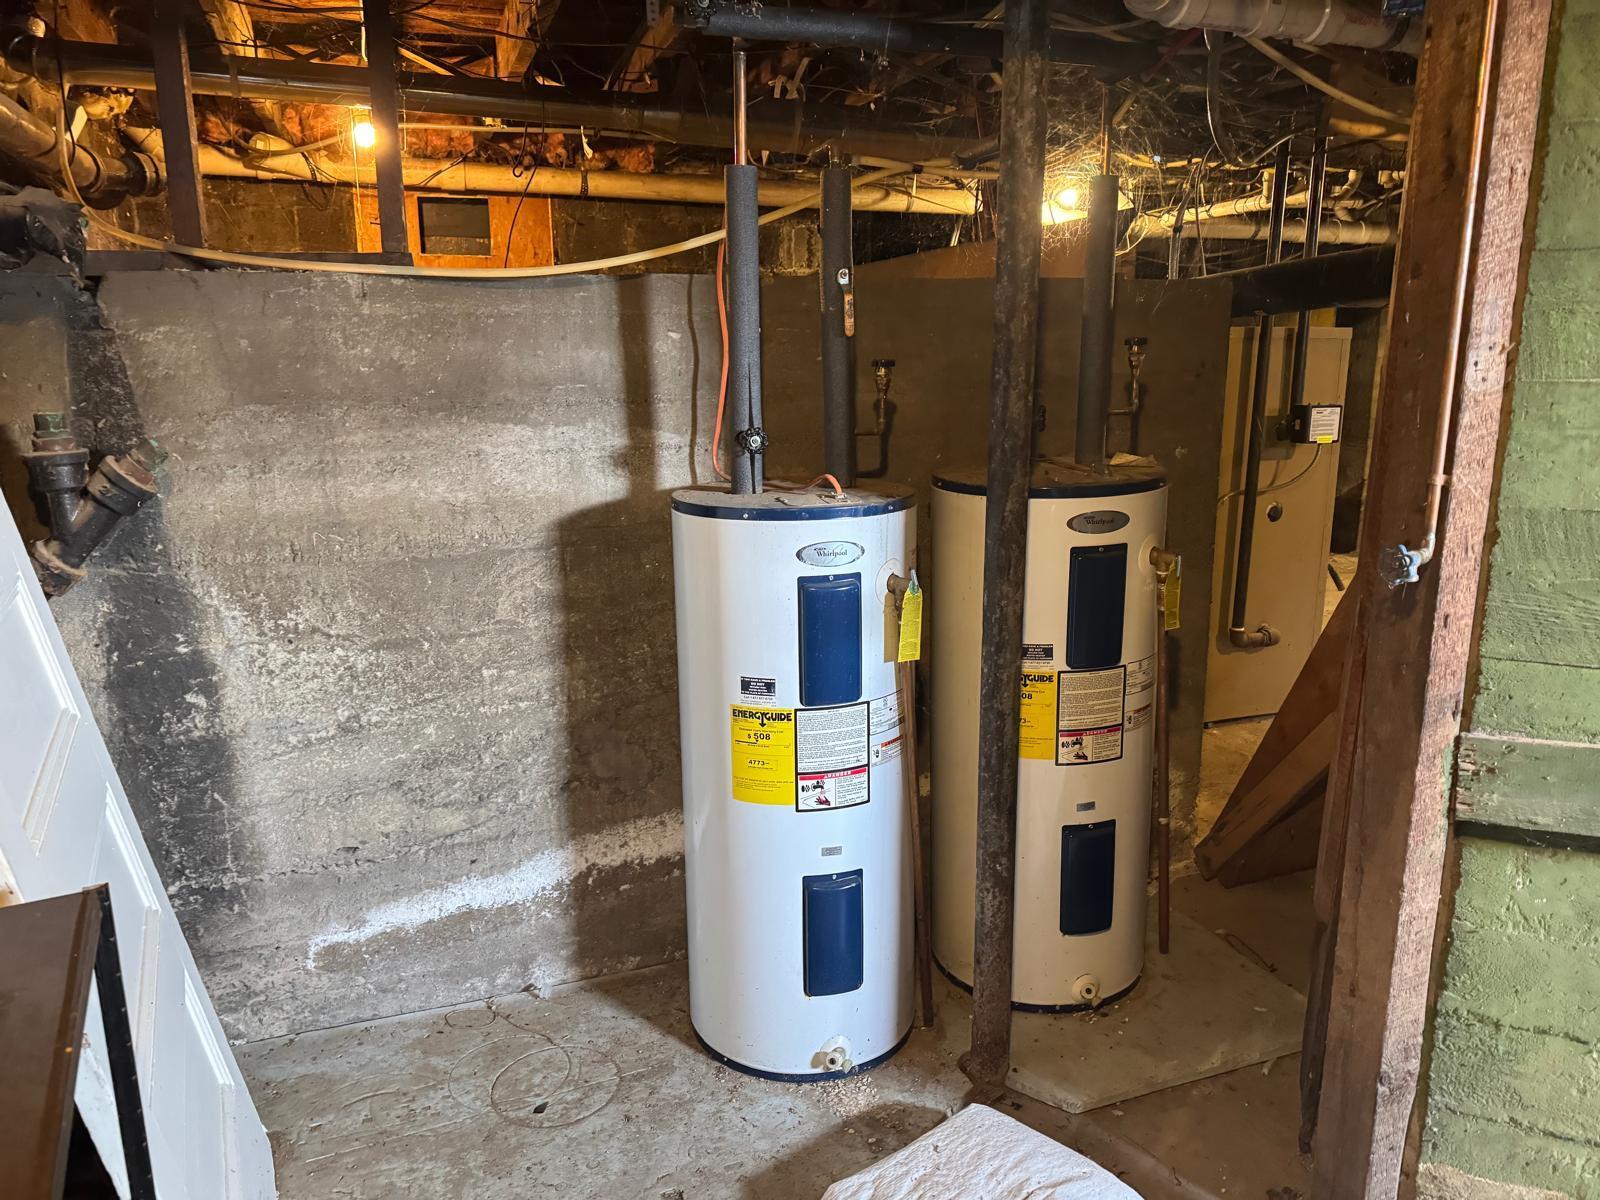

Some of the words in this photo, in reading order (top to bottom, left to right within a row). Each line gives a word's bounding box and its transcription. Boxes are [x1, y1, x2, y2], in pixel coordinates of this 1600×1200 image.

[816, 549, 848, 558] Whirlpool
[1021, 692, 1033, 700] 08
[732, 708, 792, 722] ENERGYGUIDE
[753, 732, 771, 741] 508
